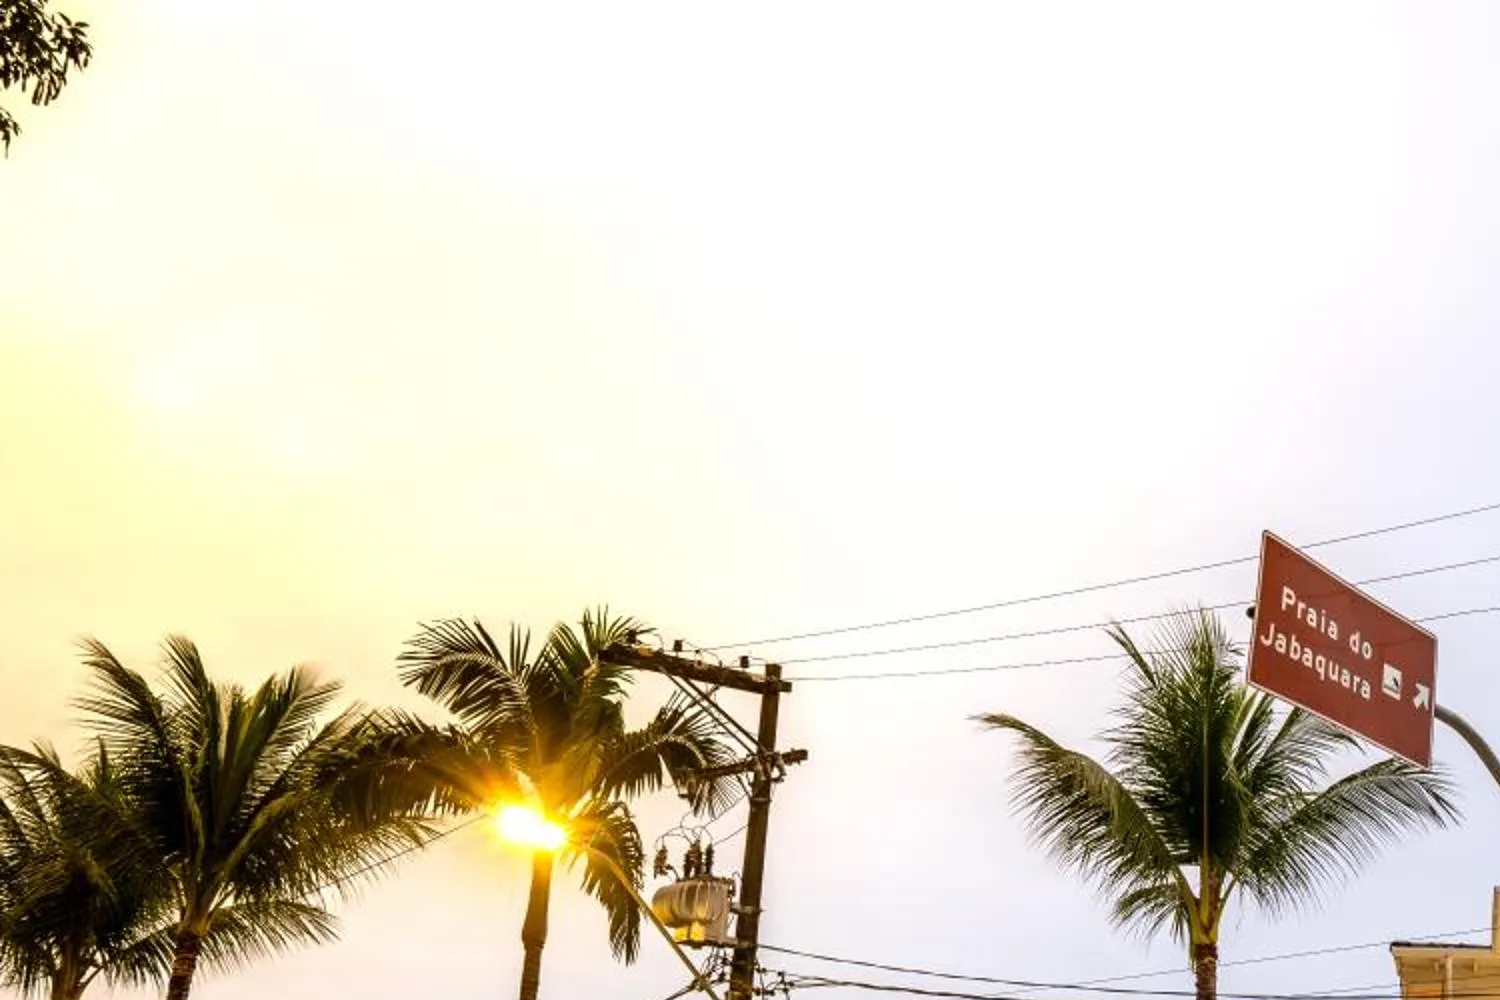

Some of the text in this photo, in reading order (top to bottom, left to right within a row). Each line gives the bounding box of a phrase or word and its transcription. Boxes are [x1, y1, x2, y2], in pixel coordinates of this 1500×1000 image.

[1281, 585, 1373, 660] Praia do
[1260, 623, 1372, 700] Jabaquara
